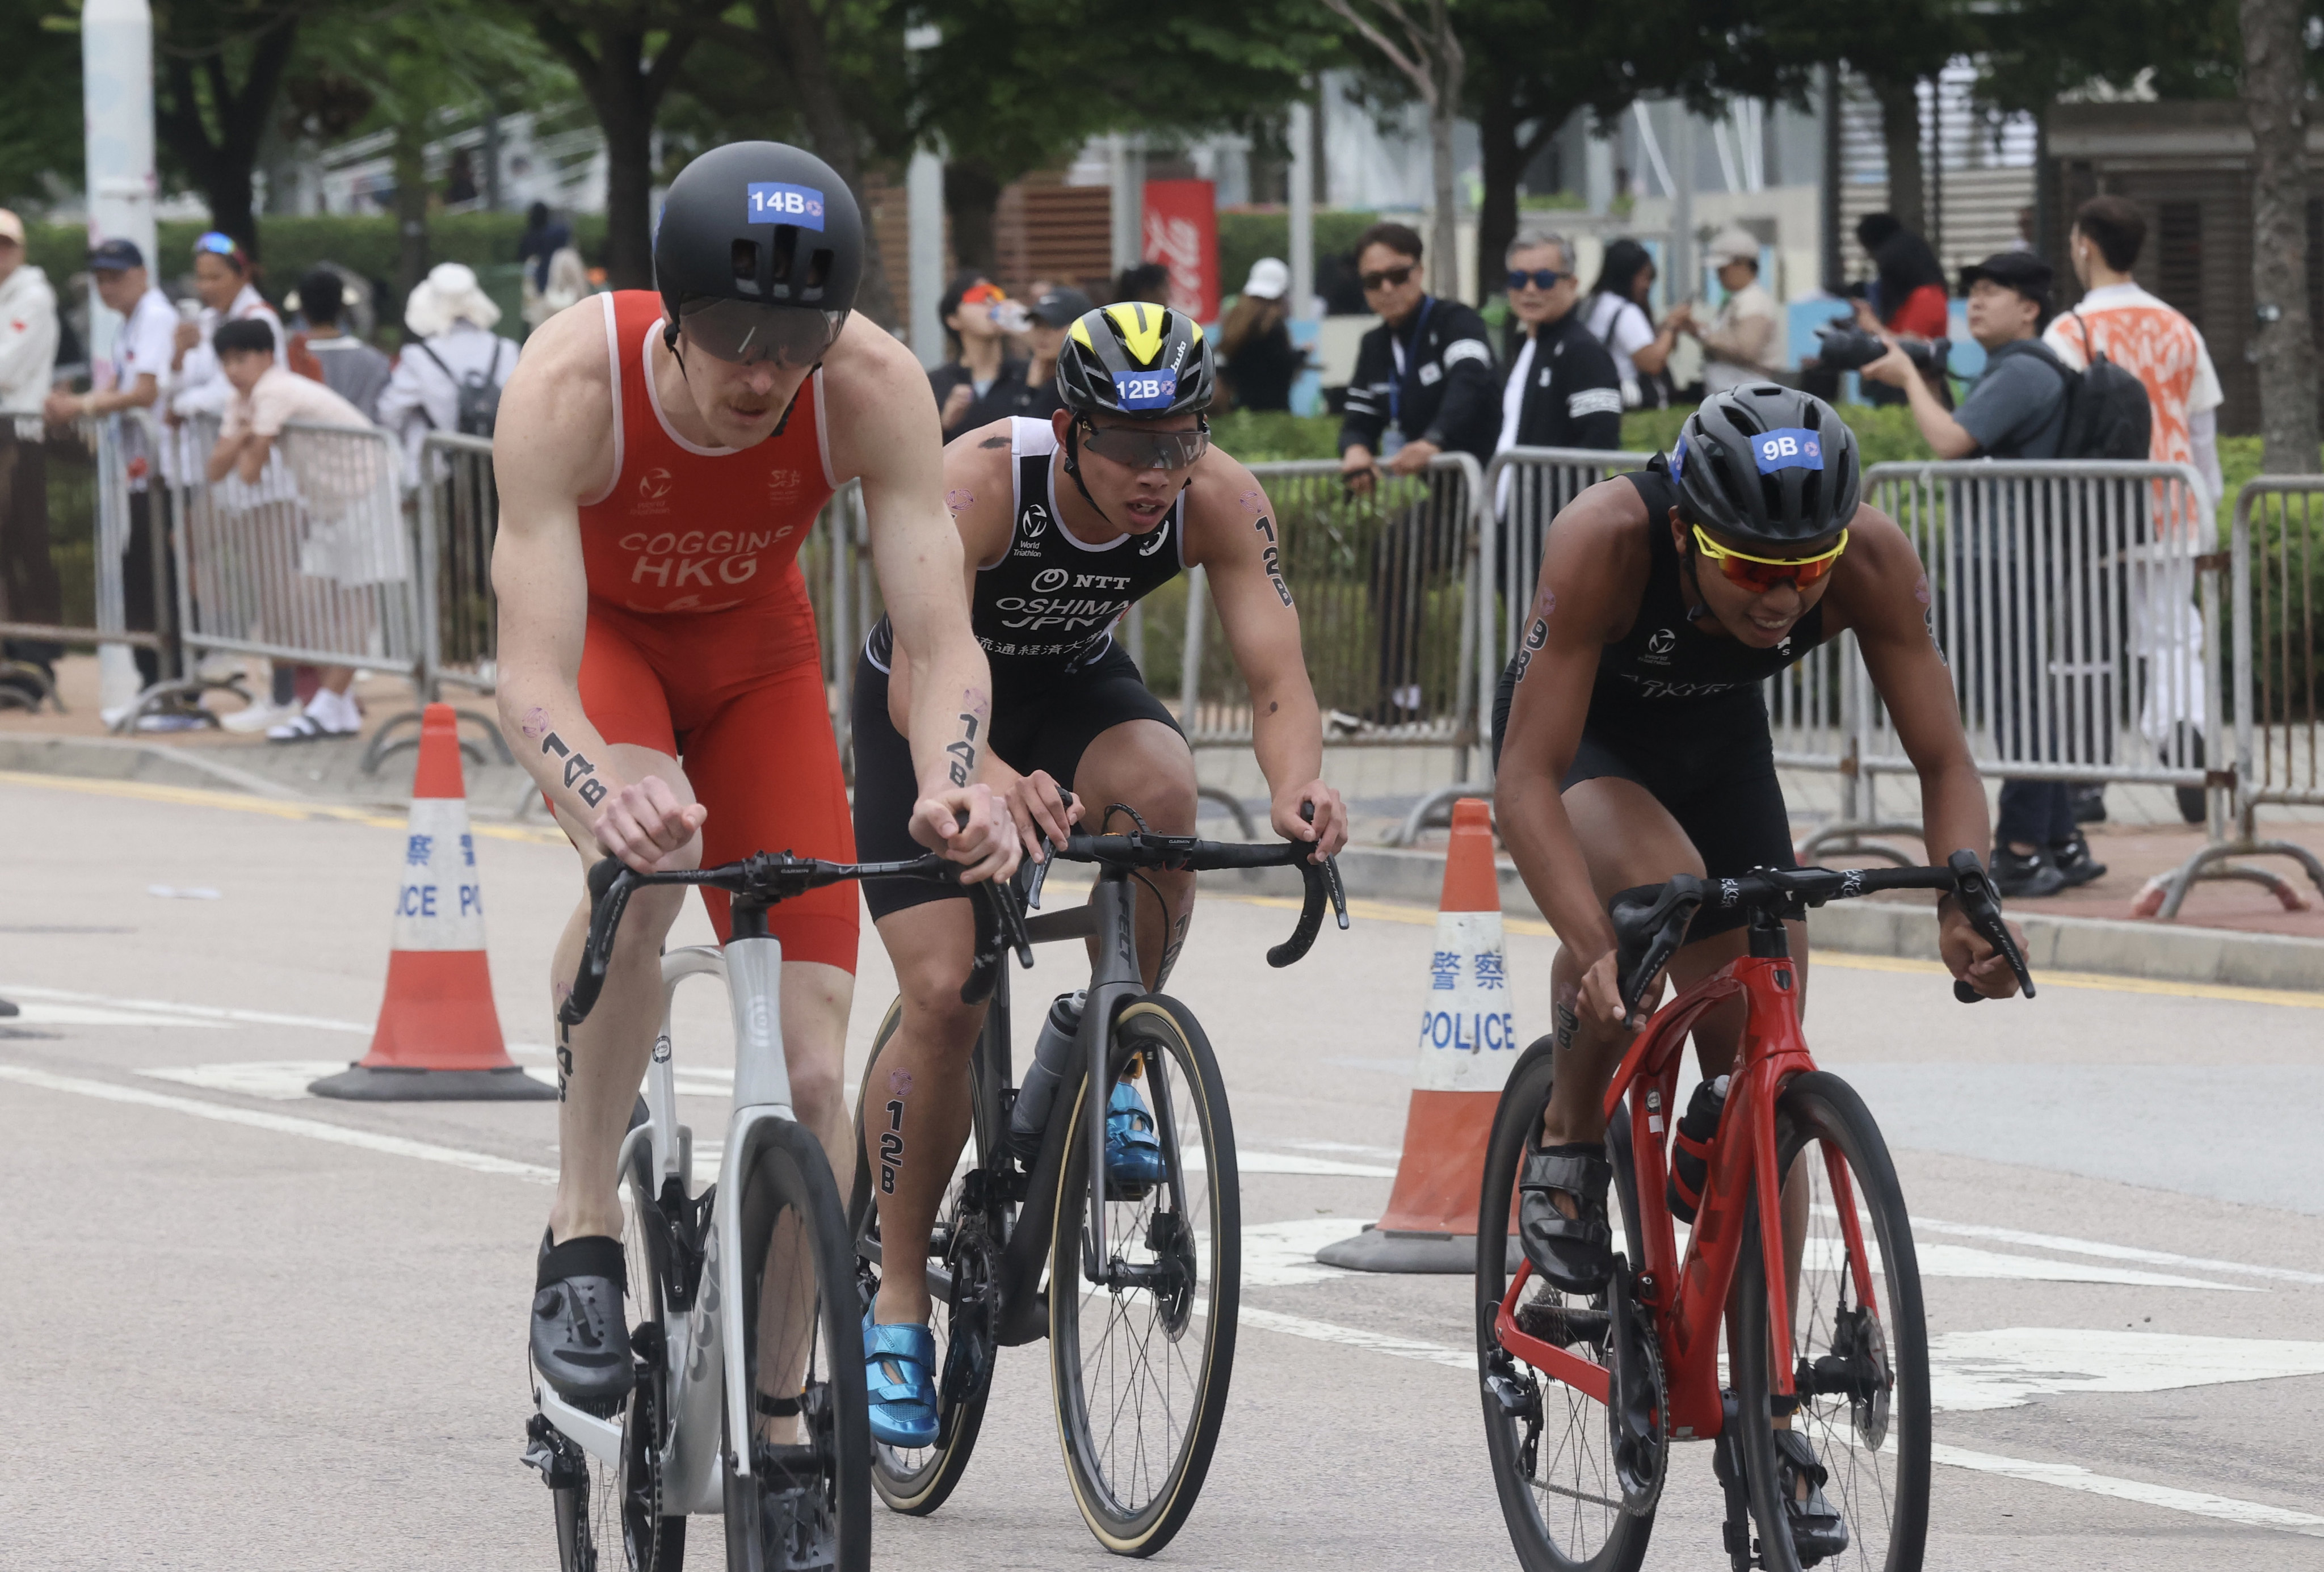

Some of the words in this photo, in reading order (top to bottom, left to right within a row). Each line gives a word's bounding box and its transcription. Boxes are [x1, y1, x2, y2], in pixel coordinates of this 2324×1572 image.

[751, 191, 805, 214] 14B
[1116, 380, 1160, 400] 12B
[1763, 436, 1798, 461] 9B
[1014, 549, 1041, 557] Triathlon
[1020, 540, 1040, 549] World
[631, 552, 757, 587] HKG
[1254, 514, 1293, 608] 12B
[1073, 574, 1131, 590] NTT
[996, 597, 1129, 615] OSHIMA
[1002, 616, 1102, 632] JPN
[945, 713, 979, 788] 14B
[541, 731, 607, 809] 14B
[1118, 896, 1131, 970] FELT
[1431, 951, 1504, 990] 警察
[1419, 1011, 1515, 1050] POLICE
[880, 1099, 905, 1196] 12B
